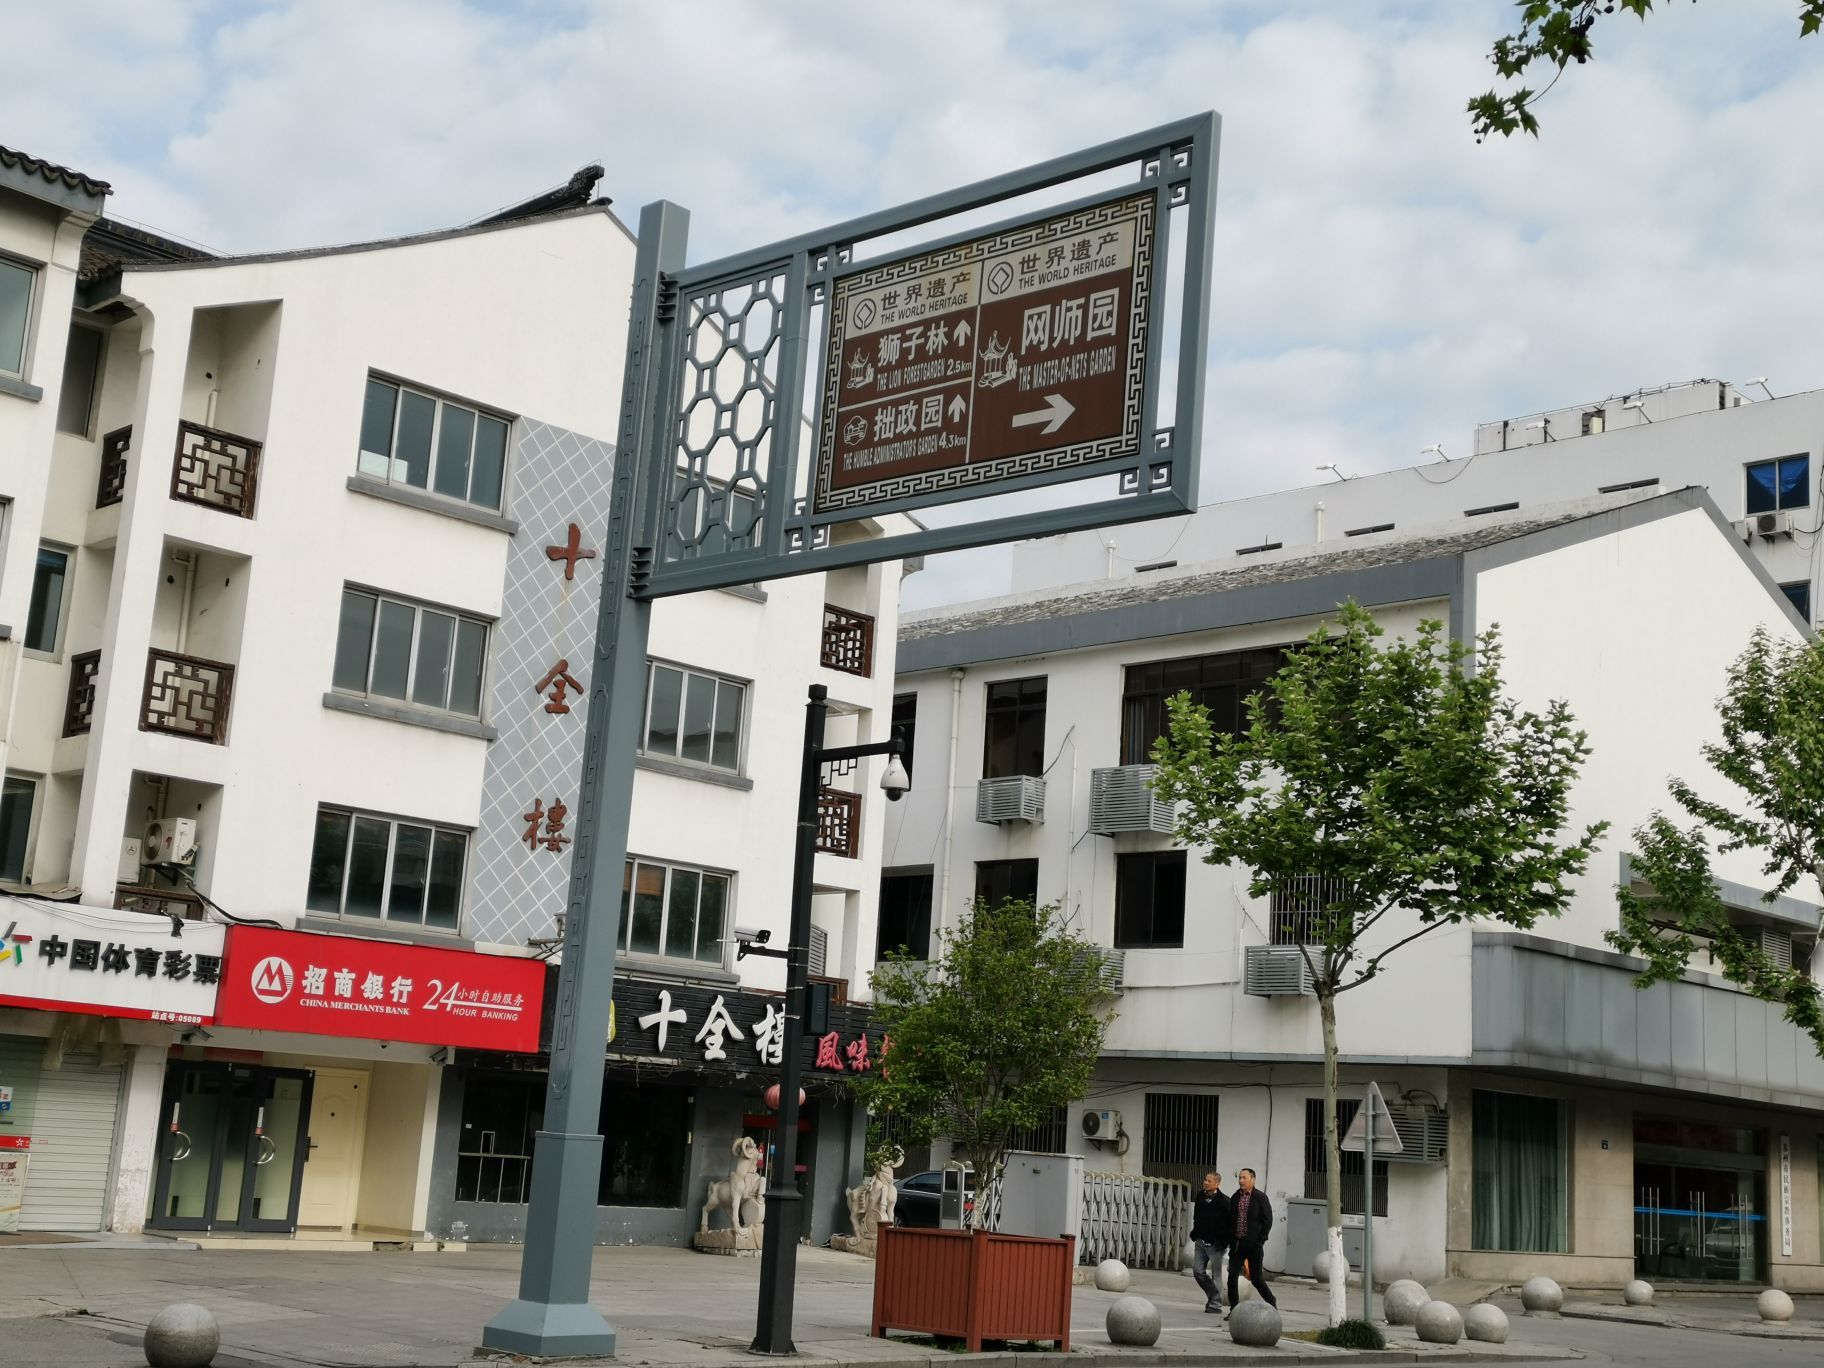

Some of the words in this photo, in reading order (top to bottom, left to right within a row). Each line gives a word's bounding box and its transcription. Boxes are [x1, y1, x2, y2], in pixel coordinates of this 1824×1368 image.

[1019, 231, 1119, 276] 世界遗产
[1019, 275, 1035, 290] THE
[1039, 267, 1070, 285] WORLD
[1073, 254, 1117, 276] HERITAGE
[880, 271, 971, 311] 世界遗产
[881, 311, 895, 325] THE
[898, 304, 926, 320] WORLD
[928, 293, 968, 312] HERITAGE
[1021, 287, 1120, 355] 网师园
[878, 320, 949, 367] 狮子林
[877, 373, 887, 392] THE
[888, 368, 902, 389] LION
[1018, 365, 1032, 392] THE
[1089, 345, 1117, 376] GARDEN
[873, 393, 944, 442] 拙政园
[843, 452, 853, 471] THE
[917, 433, 938, 456] GARDEN
[38, 934, 221, 985] 中国体育彩票
[299, 998, 328, 1008] CHINA
[330, 1000, 384, 1013] MERCHANTS
[385, 1005, 410, 1016] BANK
[422, 979, 460, 1012] 24
[457, 988, 524, 1007] 小时自助服务
[452, 1007, 477, 1017] HOUR
[481, 1010, 519, 1021] BANKING
